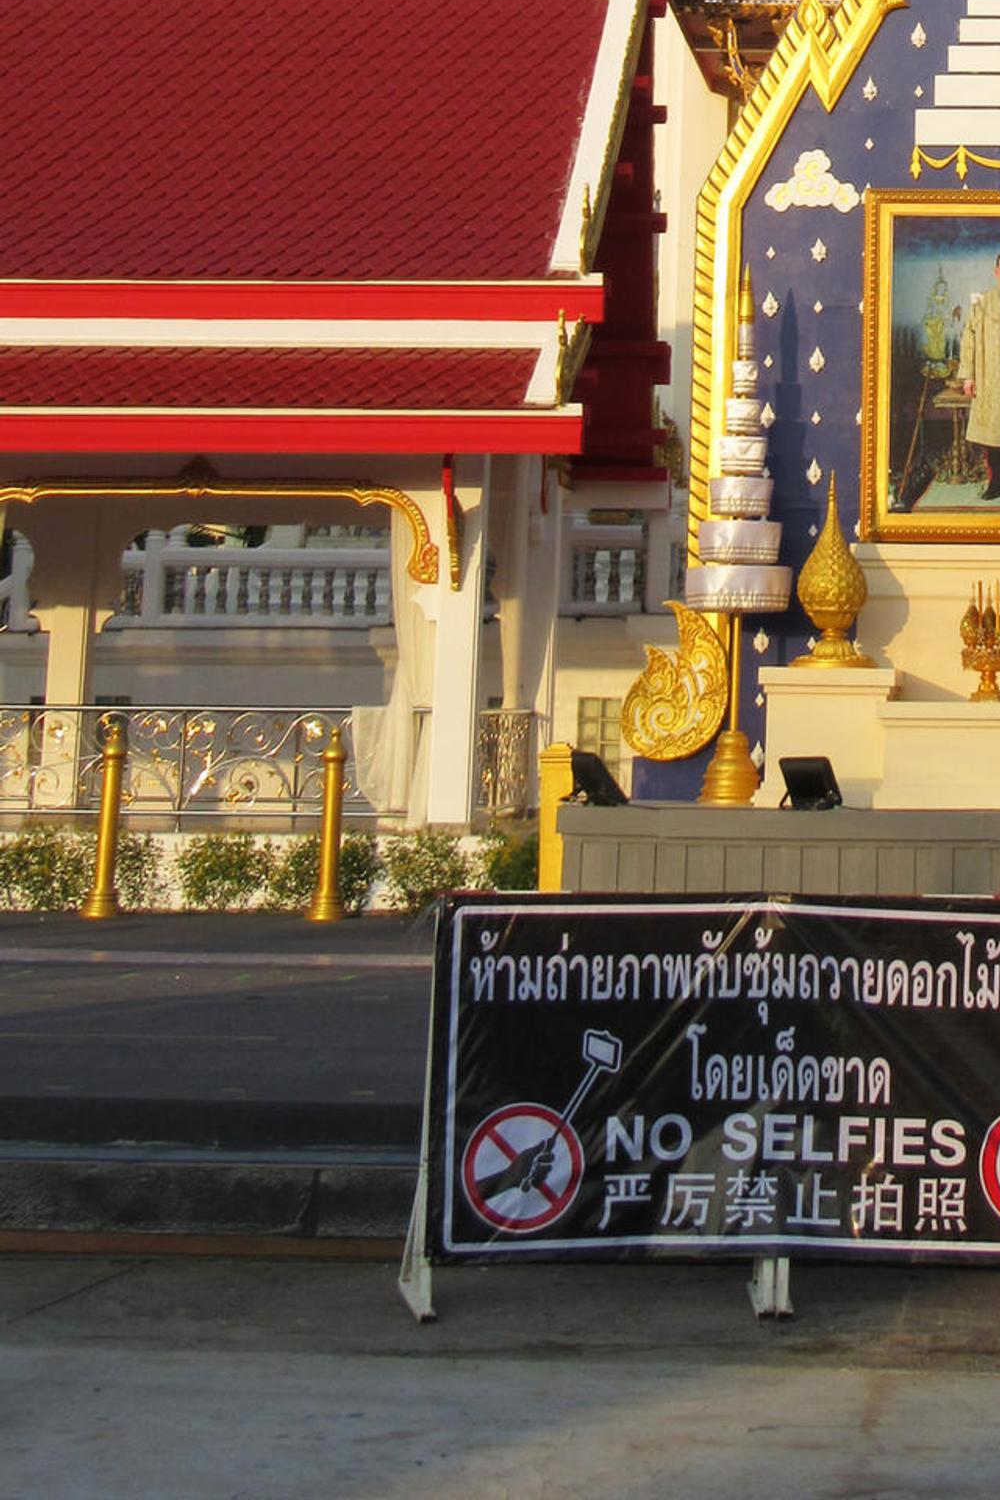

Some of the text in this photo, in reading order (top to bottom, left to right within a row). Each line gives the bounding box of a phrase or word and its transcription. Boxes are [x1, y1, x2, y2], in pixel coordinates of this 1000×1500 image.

[686, 1025, 892, 1104] โดยเด็ดขาด
[604, 1113, 967, 1167] NO SELFIES
[600, 1171, 968, 1232] 严厉禁止拍照
